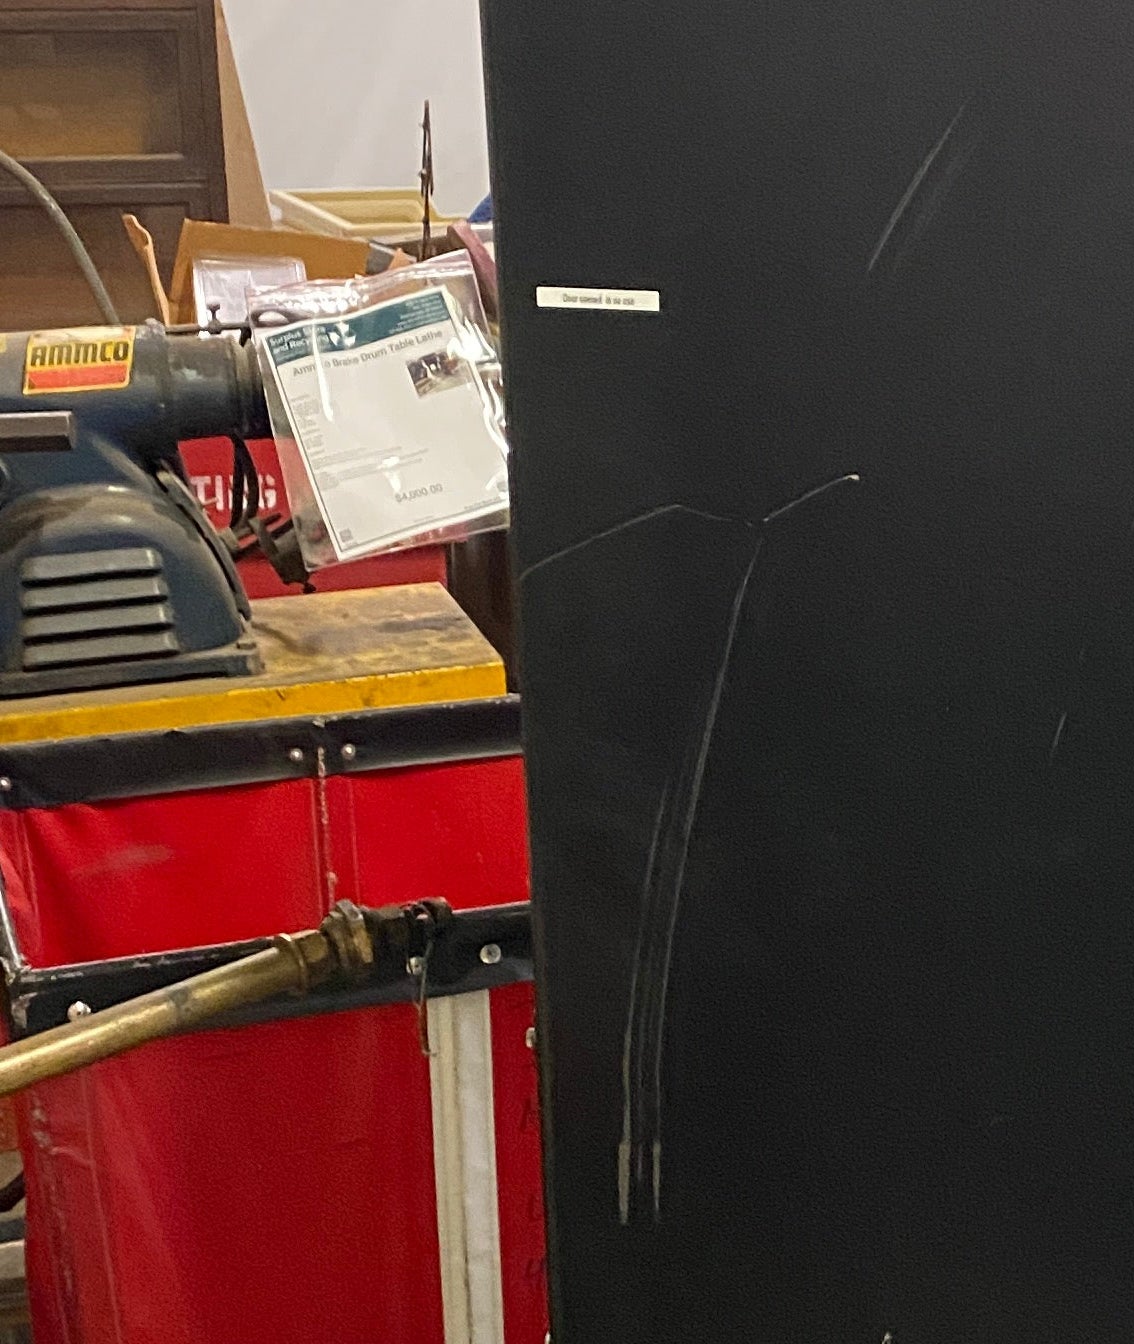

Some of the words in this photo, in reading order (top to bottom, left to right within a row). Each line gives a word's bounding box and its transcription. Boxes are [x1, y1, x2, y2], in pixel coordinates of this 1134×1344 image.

[292, 358, 331, 377] Ammo
[332, 357, 360, 369] Brake
[360, 348, 388, 363] Drum
[388, 338, 415, 353] Table
[415, 330, 444, 345] Lathe
